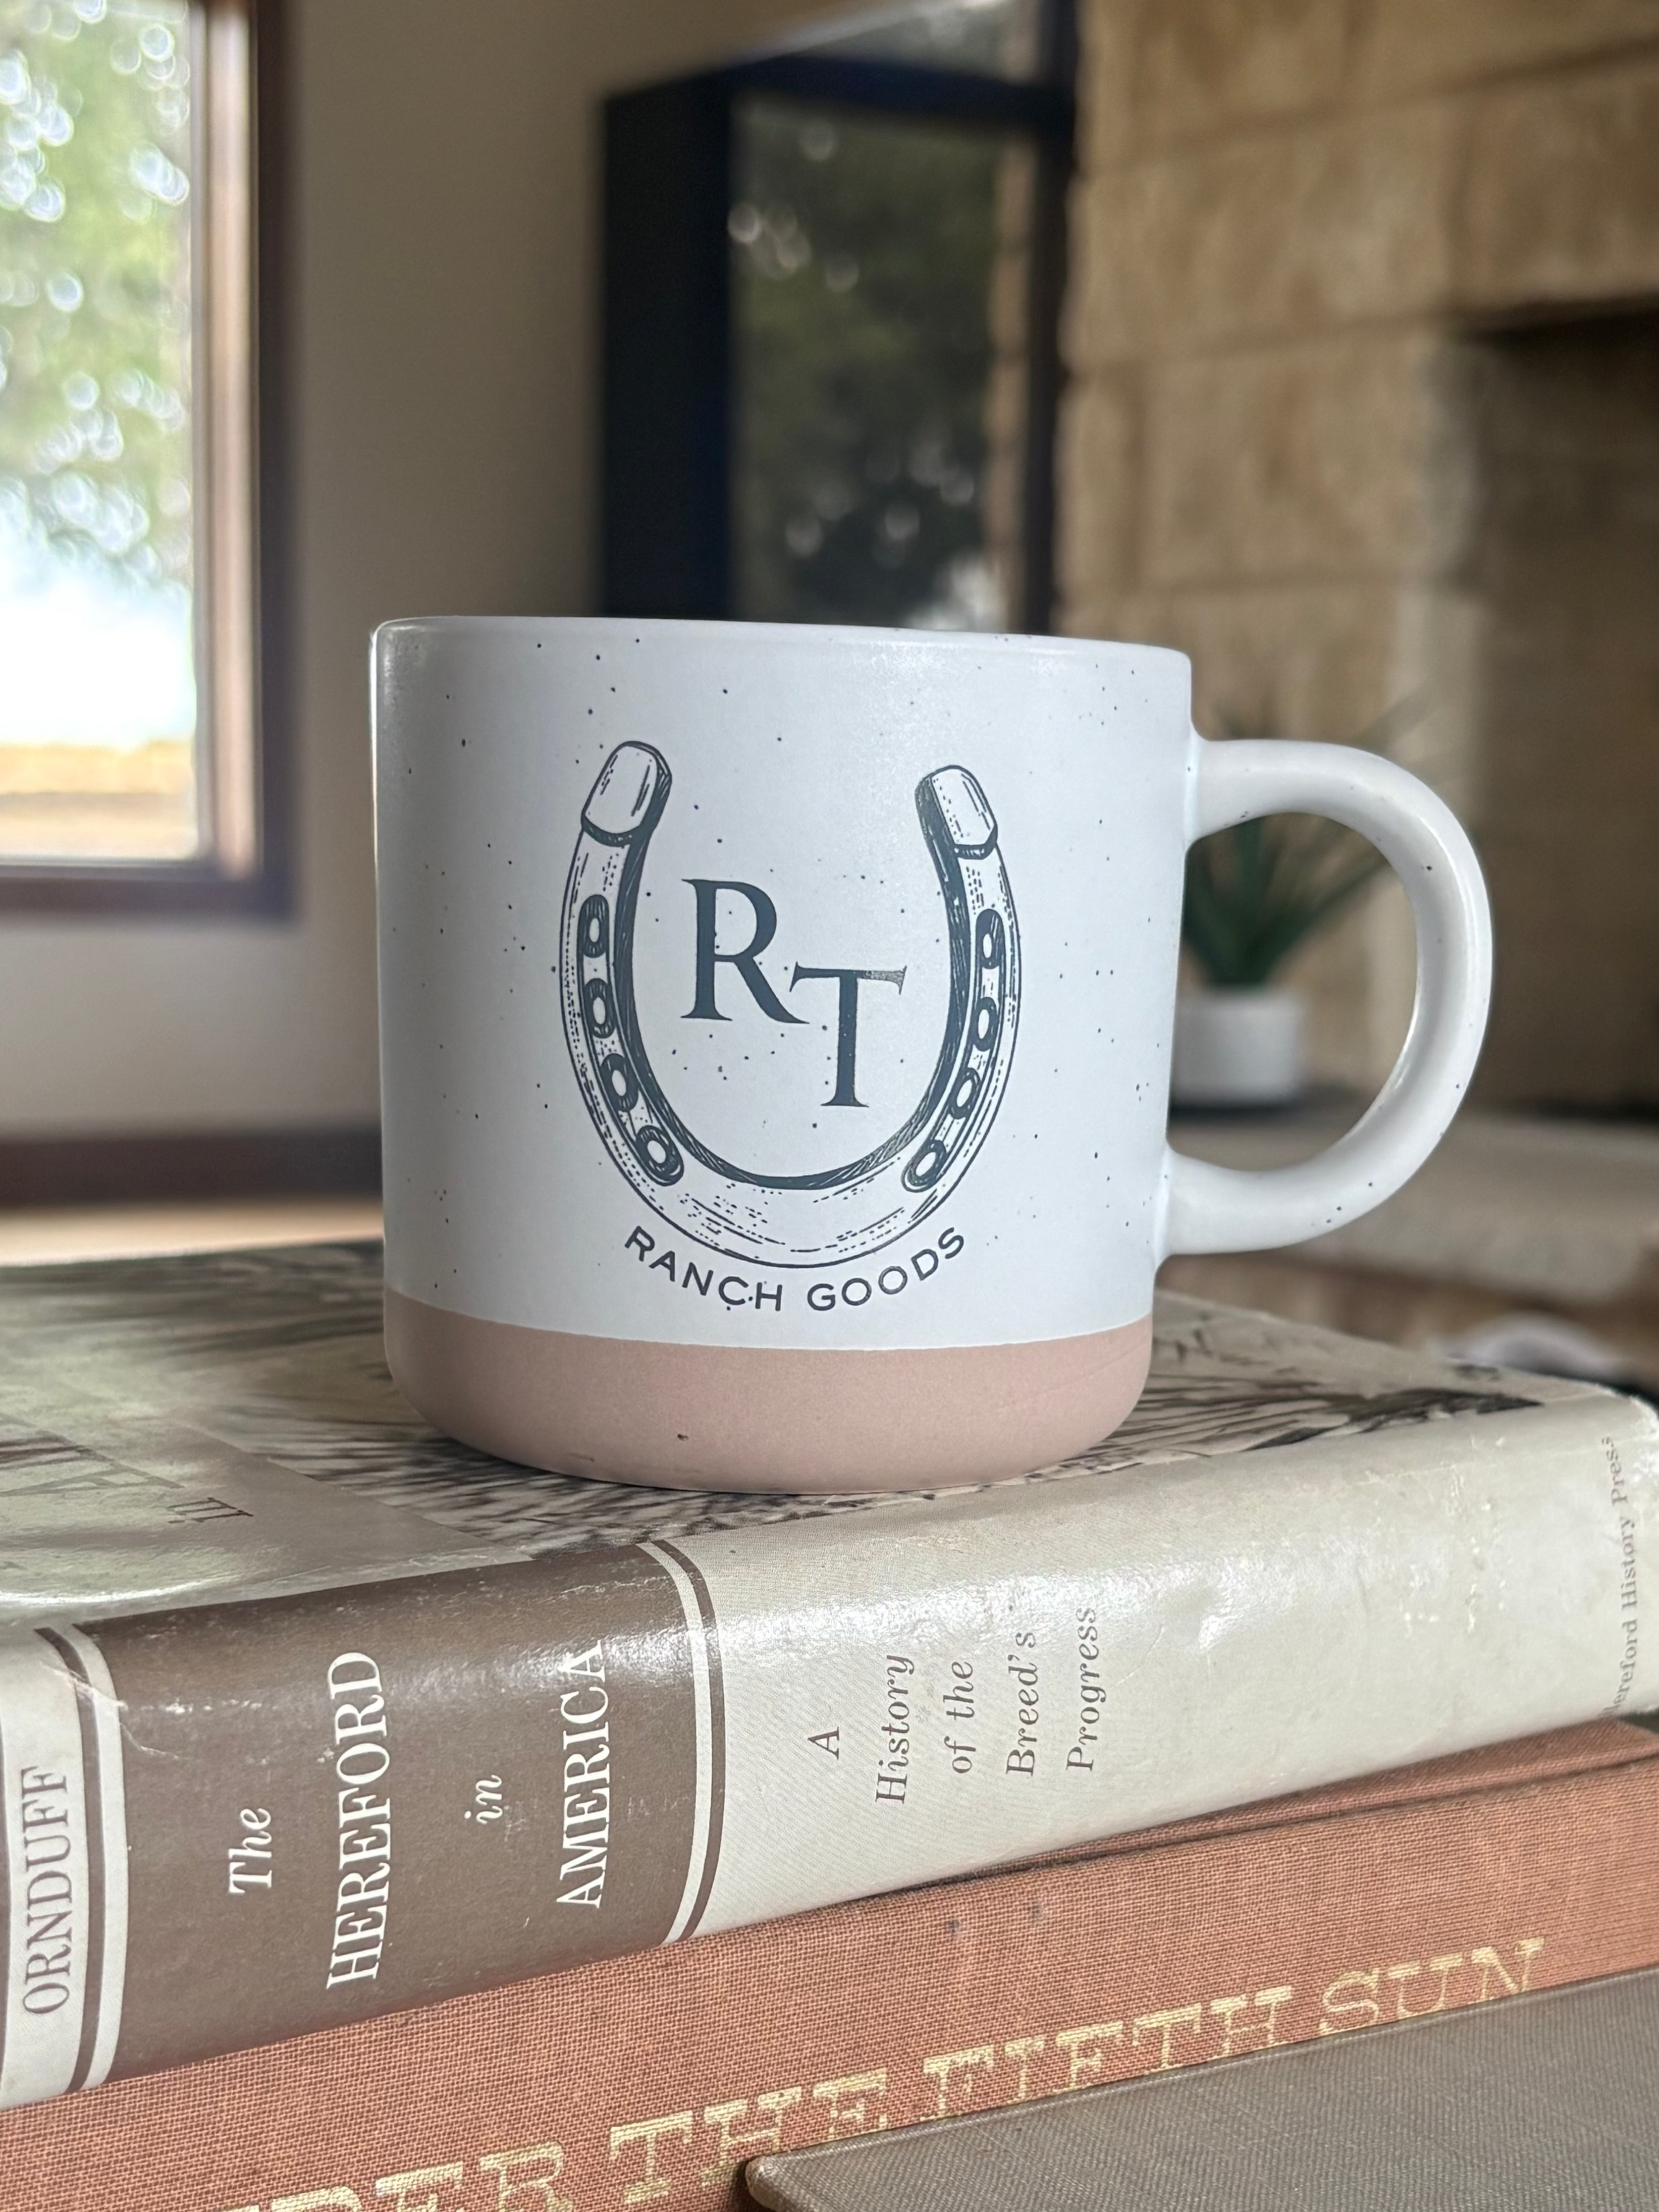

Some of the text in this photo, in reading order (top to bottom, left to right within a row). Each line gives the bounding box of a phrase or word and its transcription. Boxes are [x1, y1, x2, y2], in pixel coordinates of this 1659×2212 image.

[625, 1226, 965, 1311] RANCH GOODS
[1620, 1516, 1637, 1614] History
[808, 1727, 839, 1760] A
[875, 1655, 914, 1804] History
[943, 1661, 976, 1774] of the
[1006, 1631, 1039, 1776] Breed's
[1066, 1607, 1106, 1771] Progress
[327, 1652, 391, 1990] HEREFORD
[464, 1774, 502, 1825] in
[556, 1639, 610, 1908] AMERICA
[21, 1766, 72, 2015] ORNDUFF
[229, 1808, 273, 1896] The
[610, 2070, 887, 2204] THE
[920, 1985, 1292, 2121] FIFTH
[1318, 1936, 1547, 2035] SUN
